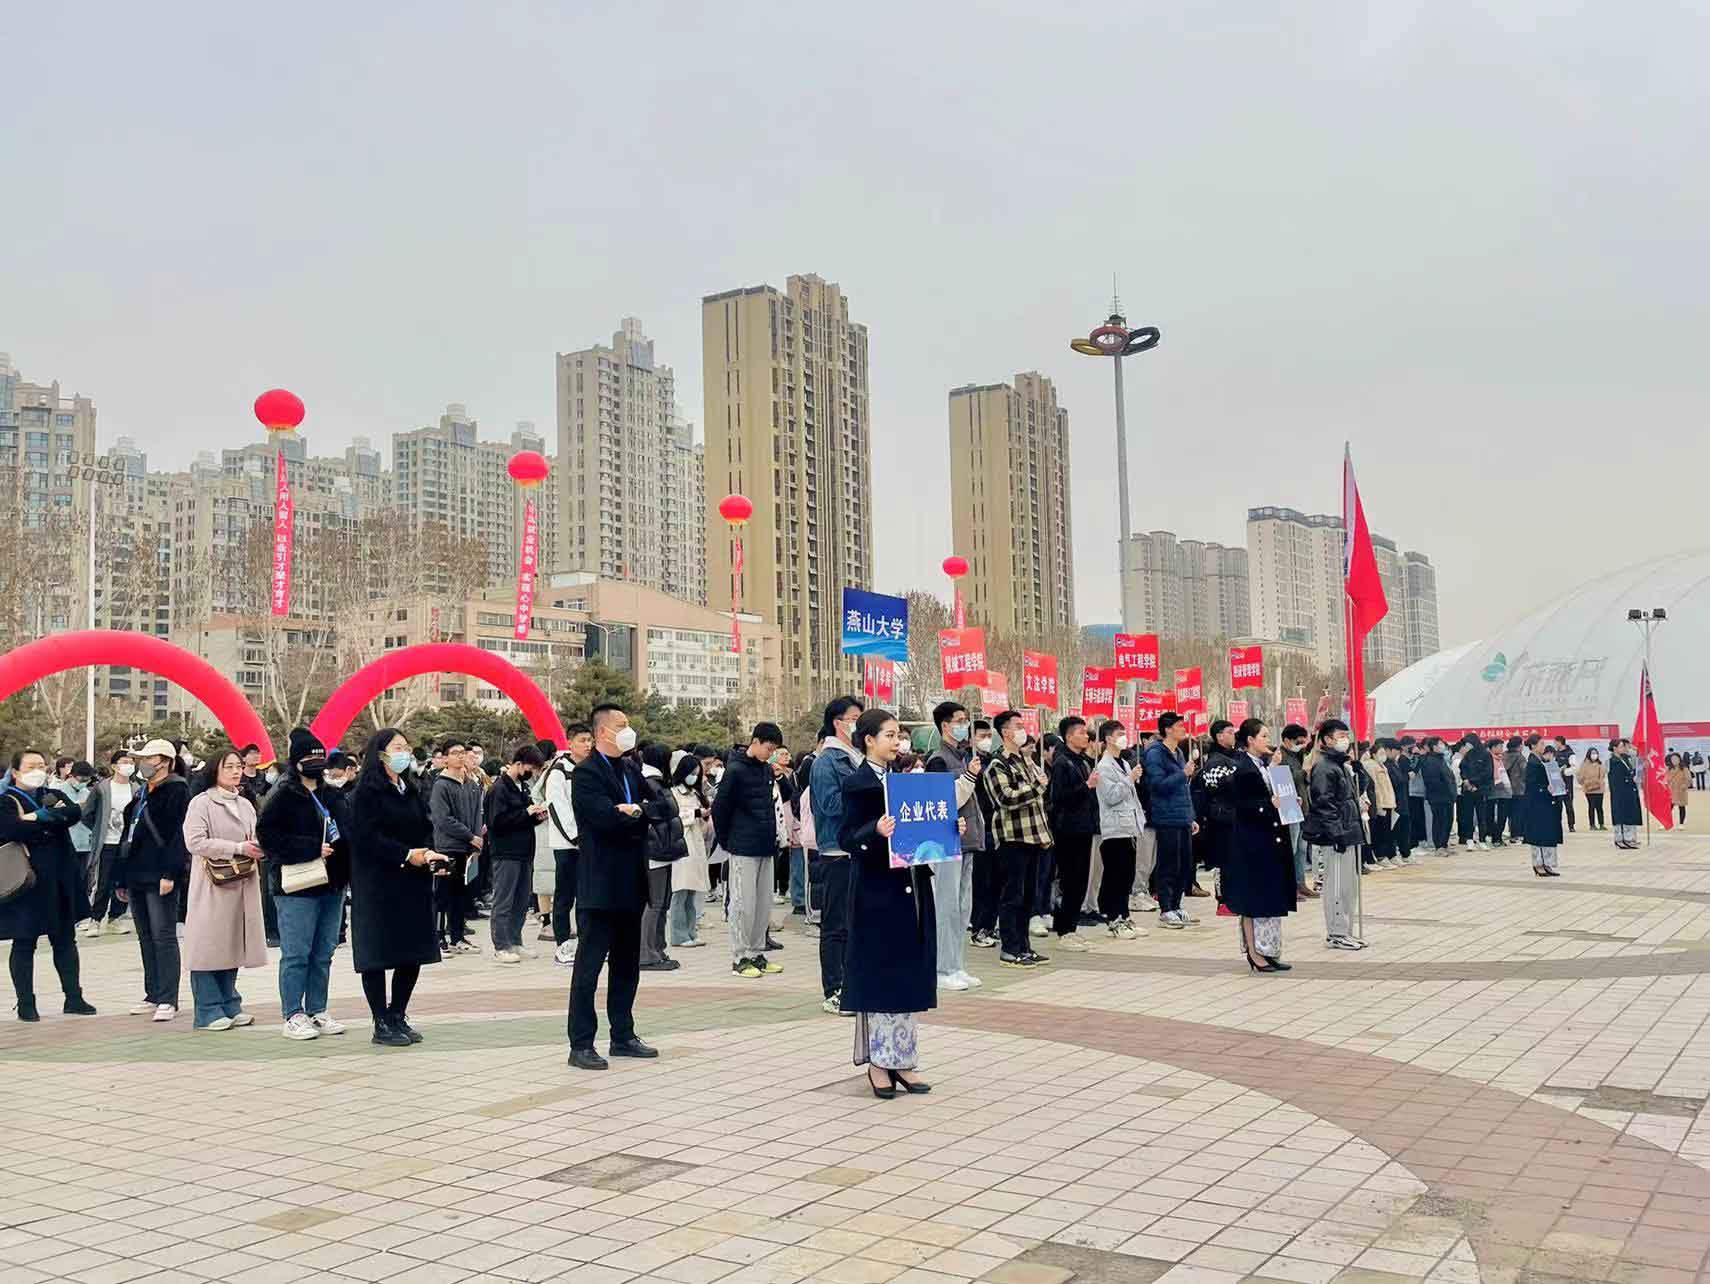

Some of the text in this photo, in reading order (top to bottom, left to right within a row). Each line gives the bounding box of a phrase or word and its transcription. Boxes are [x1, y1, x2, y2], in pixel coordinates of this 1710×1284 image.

[847, 609, 904, 640] 燕山大学
[944, 652, 985, 674] 机械工程学院
[1118, 653, 1157, 669] 电气工程学院
[1025, 672, 1056, 695] 文法学院
[900, 800, 949, 823] 企业代表
